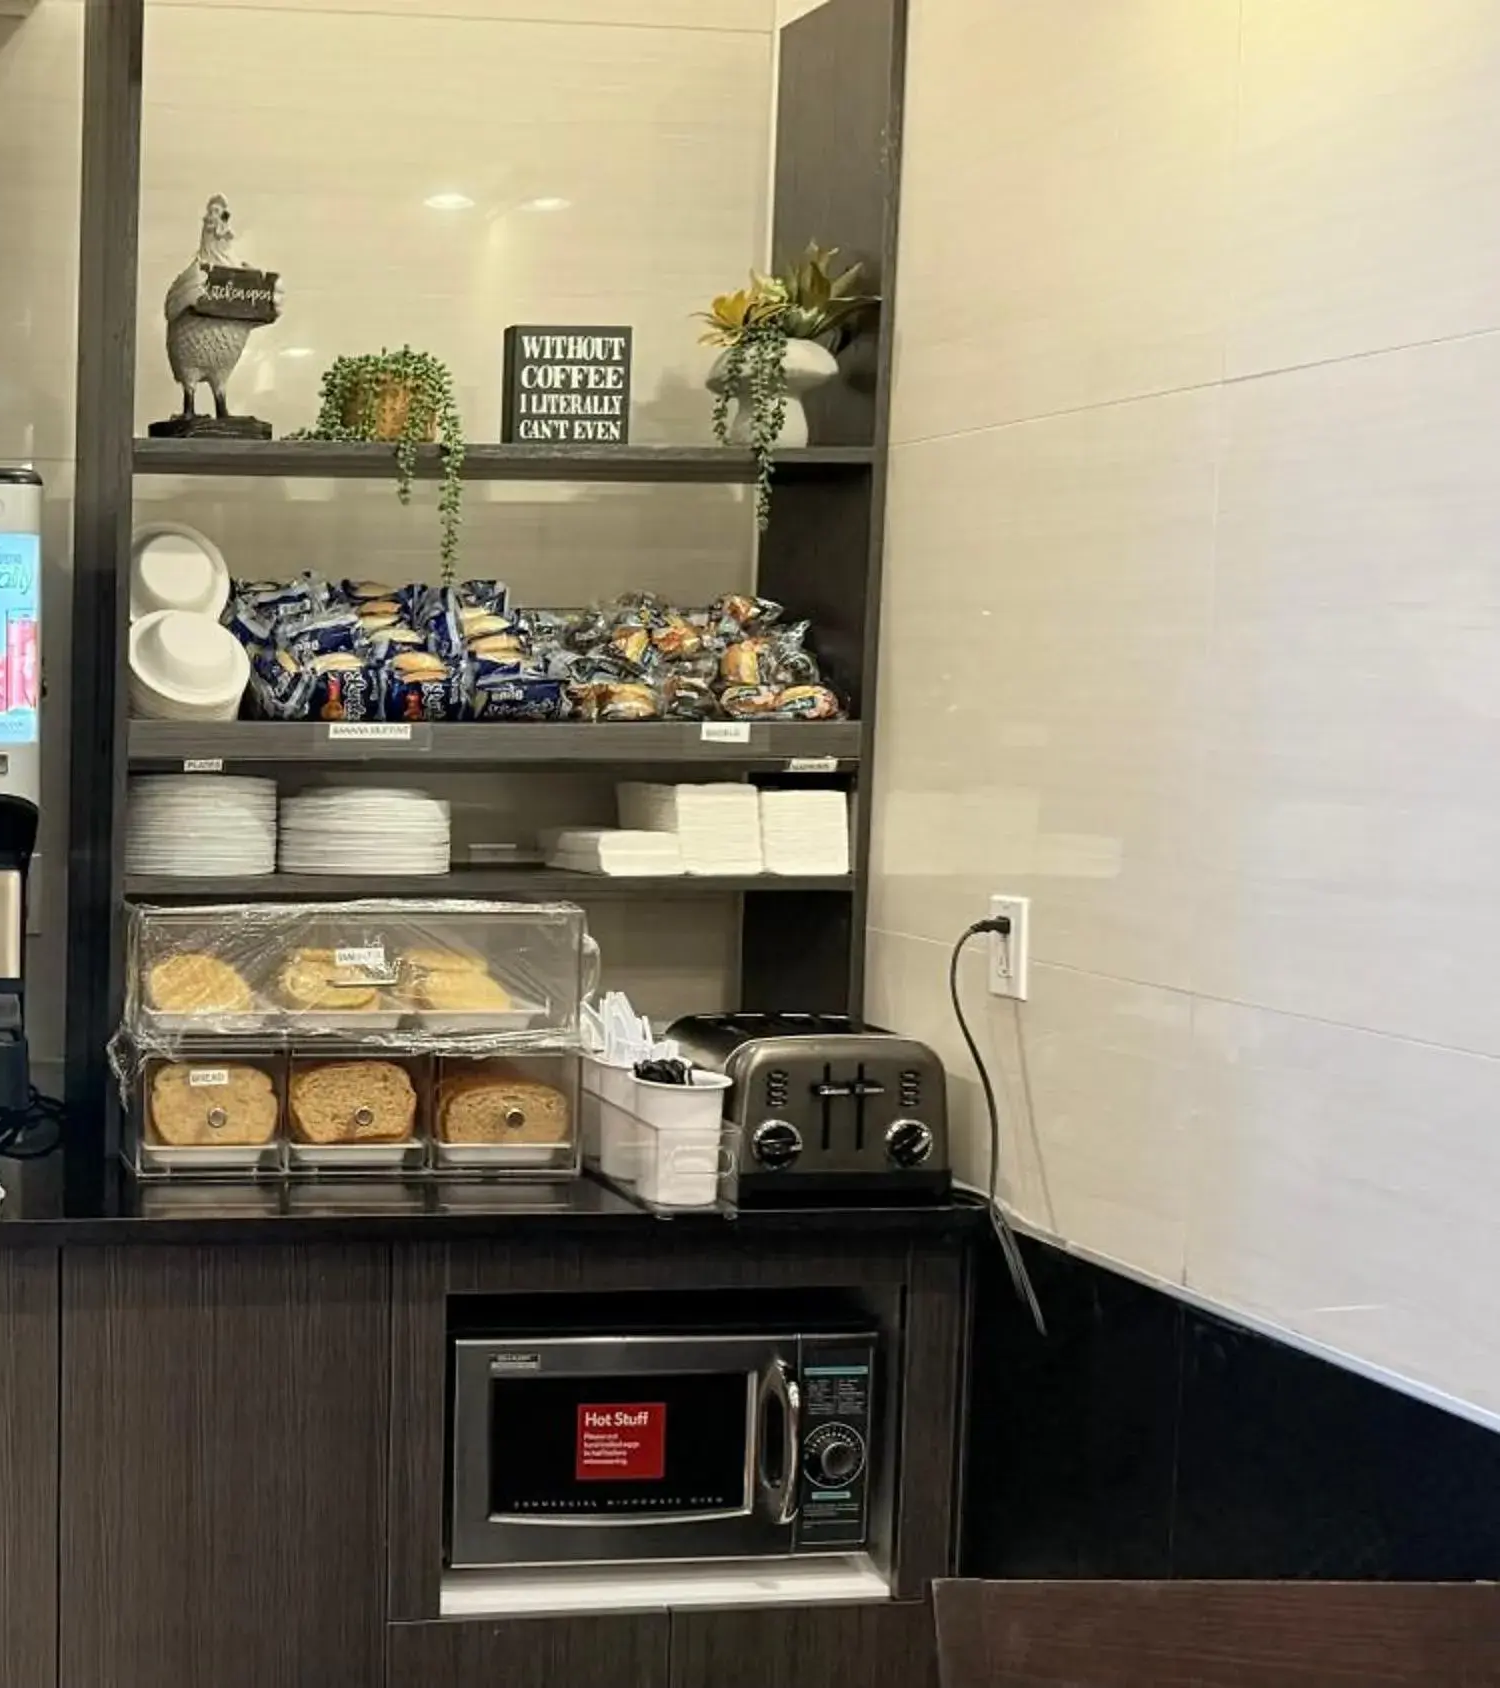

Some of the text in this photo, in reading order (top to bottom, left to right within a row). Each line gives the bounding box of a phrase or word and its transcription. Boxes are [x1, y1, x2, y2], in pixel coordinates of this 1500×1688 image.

[521, 335, 625, 360] WITHOUT
[520, 364, 624, 389] COFFEE
[520, 393, 622, 415] I LITERALLY
[519, 419, 622, 440] CAN'T EVEN
[585, 1411, 649, 1427] Hot Stuff
